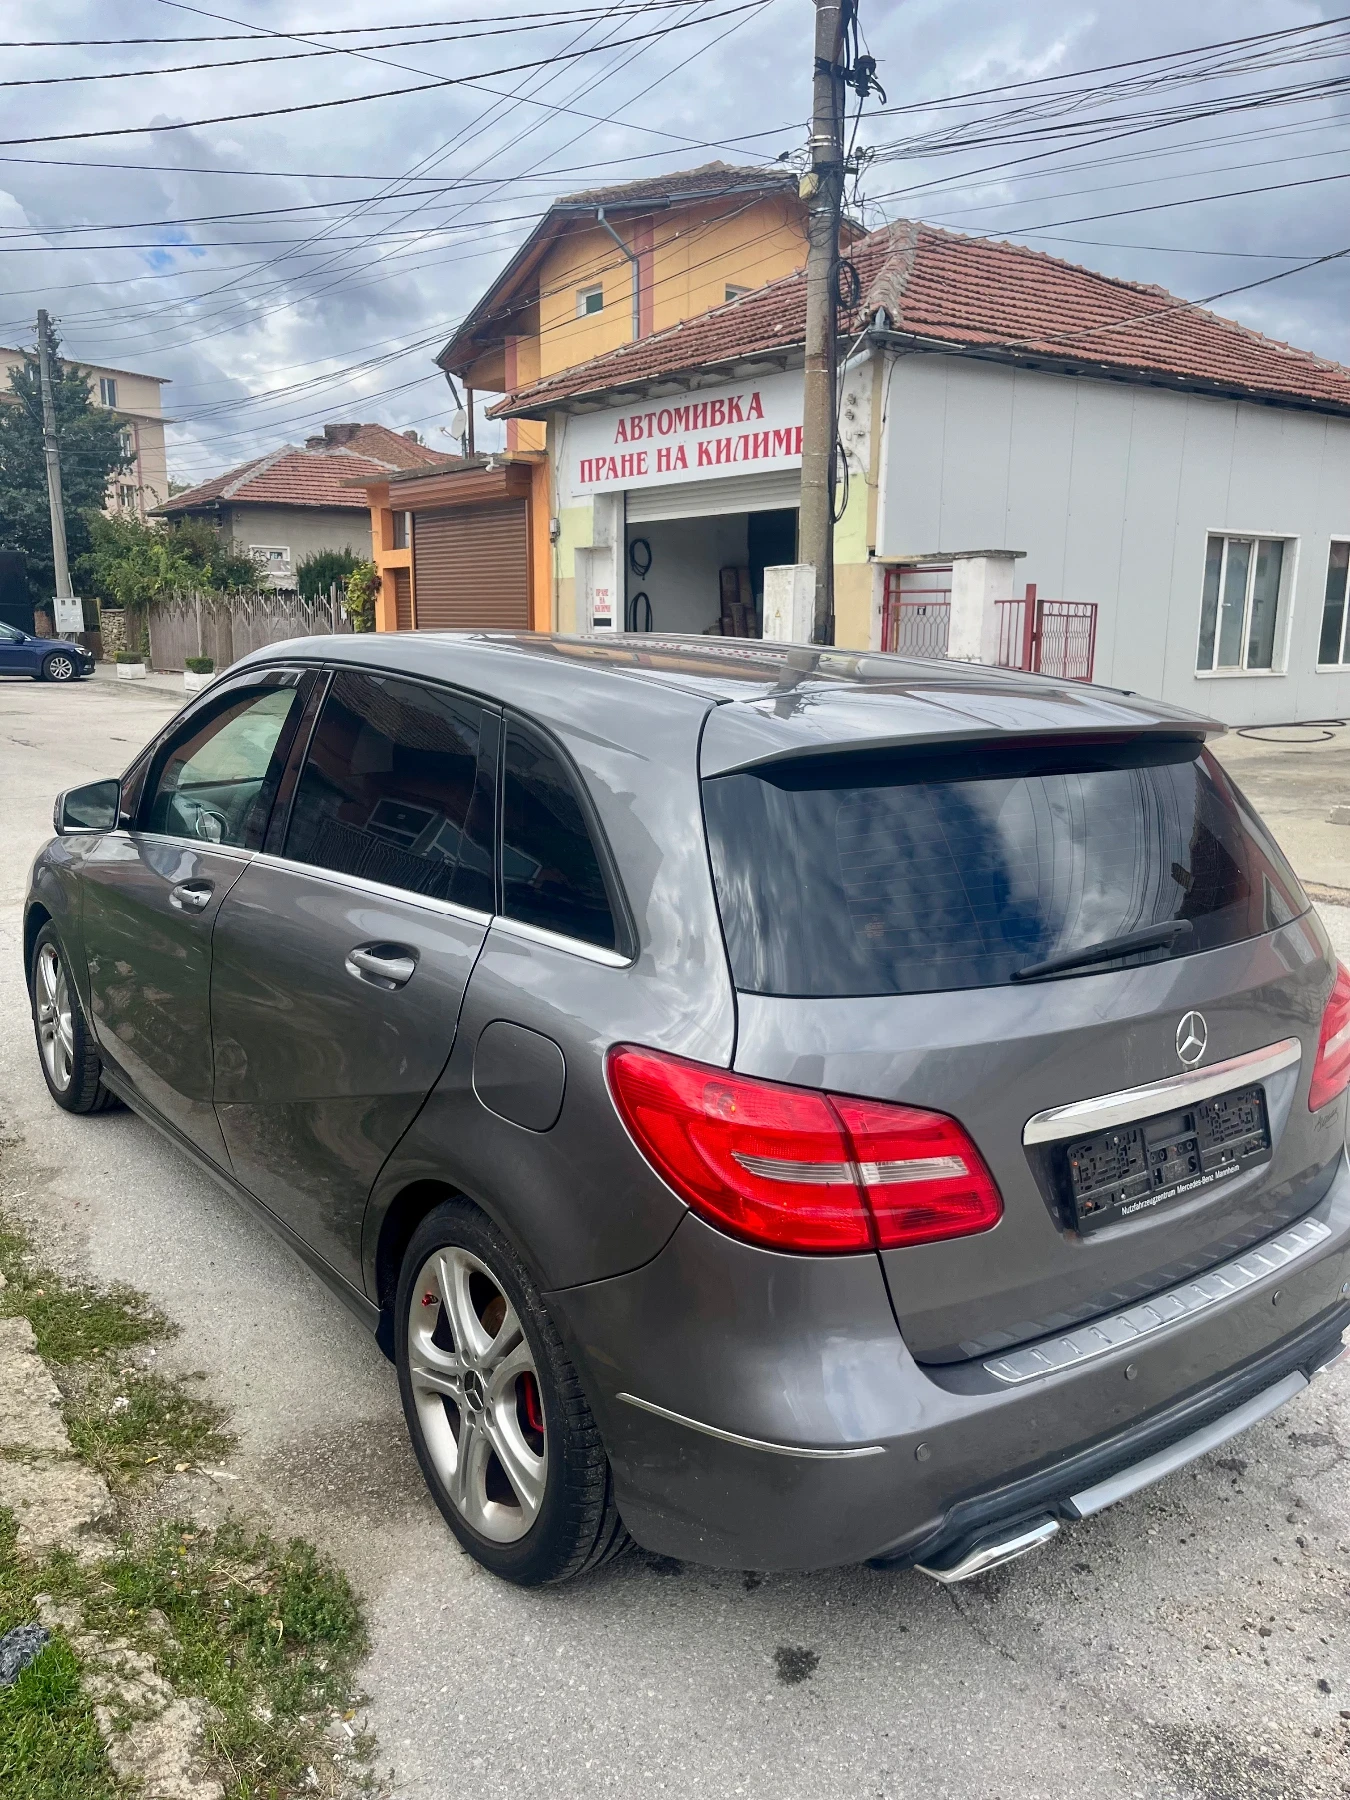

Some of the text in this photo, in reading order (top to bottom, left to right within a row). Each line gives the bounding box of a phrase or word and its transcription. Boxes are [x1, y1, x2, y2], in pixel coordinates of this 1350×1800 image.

[615, 392, 765, 444] АВТОМИВКА
[580, 451, 648, 483] ПРАНЕ
[657, 445, 689, 473] НА
[1121, 1164, 1240, 1215] Nutzfahrzeugzentrum Mercedes-Benz Mannheim
